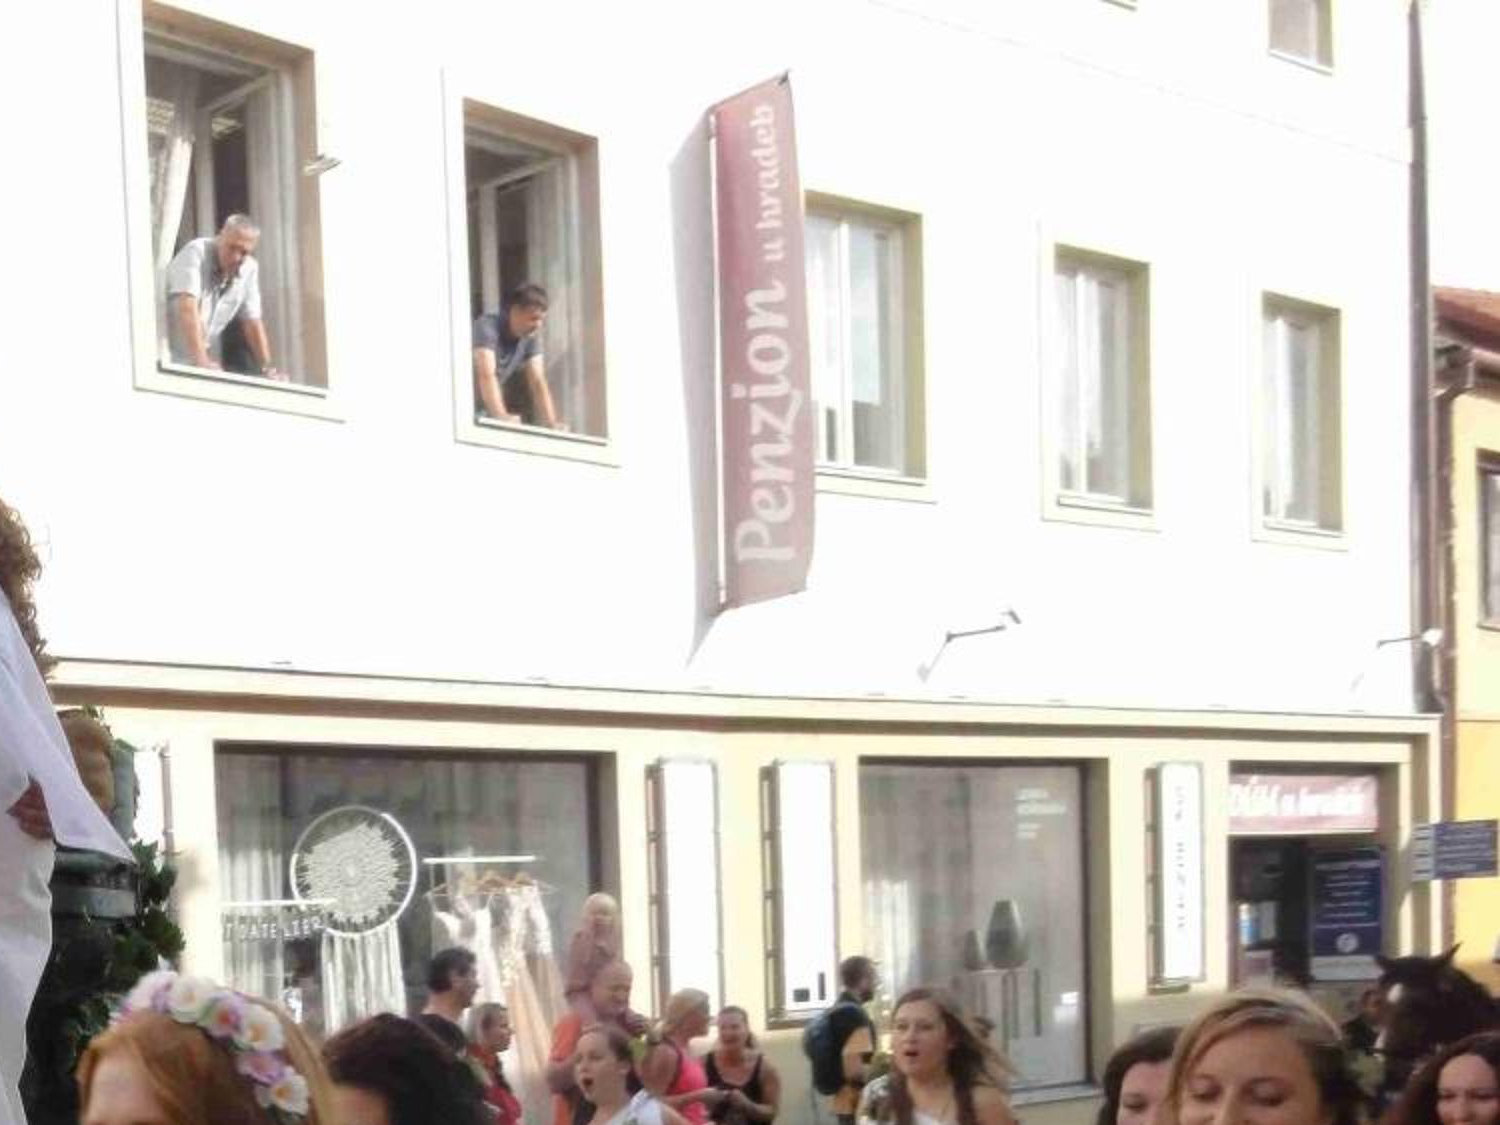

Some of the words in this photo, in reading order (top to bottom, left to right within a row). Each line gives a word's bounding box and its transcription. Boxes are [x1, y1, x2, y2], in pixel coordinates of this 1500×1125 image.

[749, 103, 784, 230] hradeb
[762, 236, 787, 262] u
[732, 279, 802, 563] Penzion
